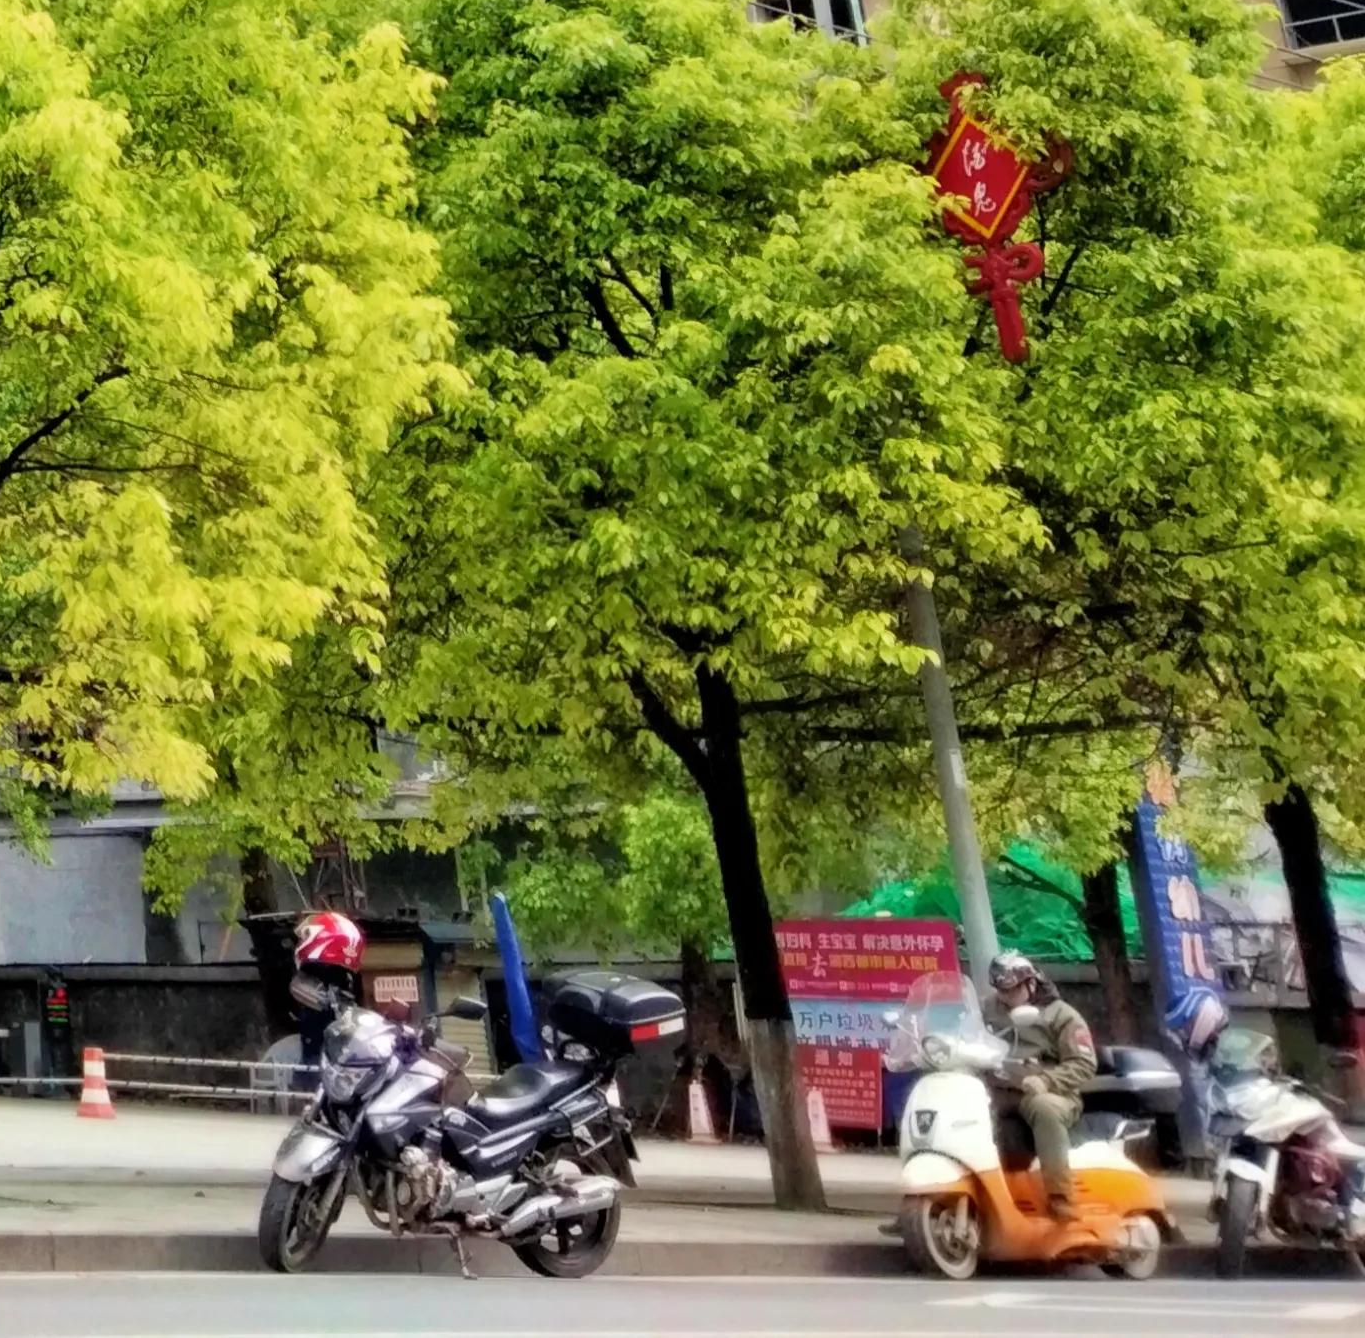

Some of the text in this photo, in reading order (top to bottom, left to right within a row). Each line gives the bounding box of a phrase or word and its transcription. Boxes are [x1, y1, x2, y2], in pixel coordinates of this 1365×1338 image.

[818, 932, 857, 950] 生宝宝
[862, 933, 944, 953] 解决意外怀孕
